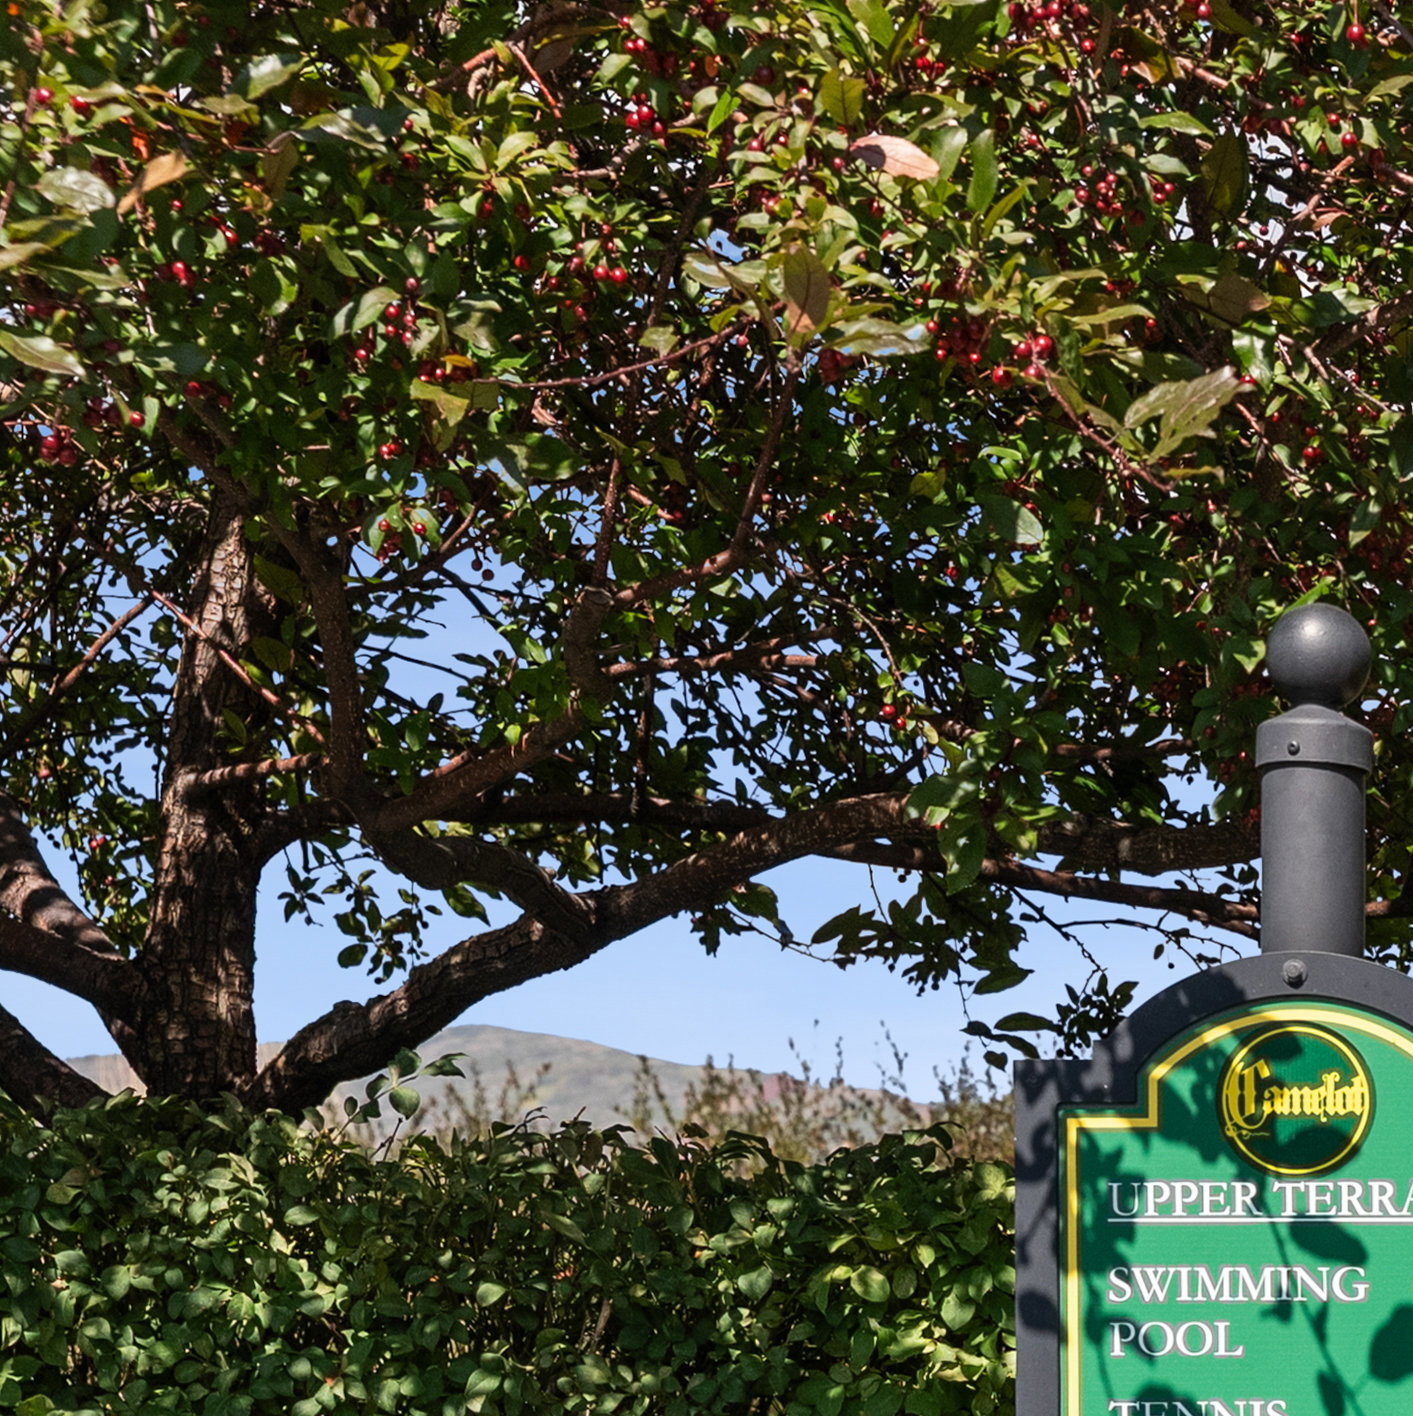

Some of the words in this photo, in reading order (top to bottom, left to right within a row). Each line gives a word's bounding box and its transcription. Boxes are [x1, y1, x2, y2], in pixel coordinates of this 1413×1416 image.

[1225, 1058, 1368, 1130] Camelot
[1107, 1180, 1263, 1217] UPPER
[1108, 1266, 1370, 1302] SWIMMING
[1110, 1321, 1244, 1357] POOL
